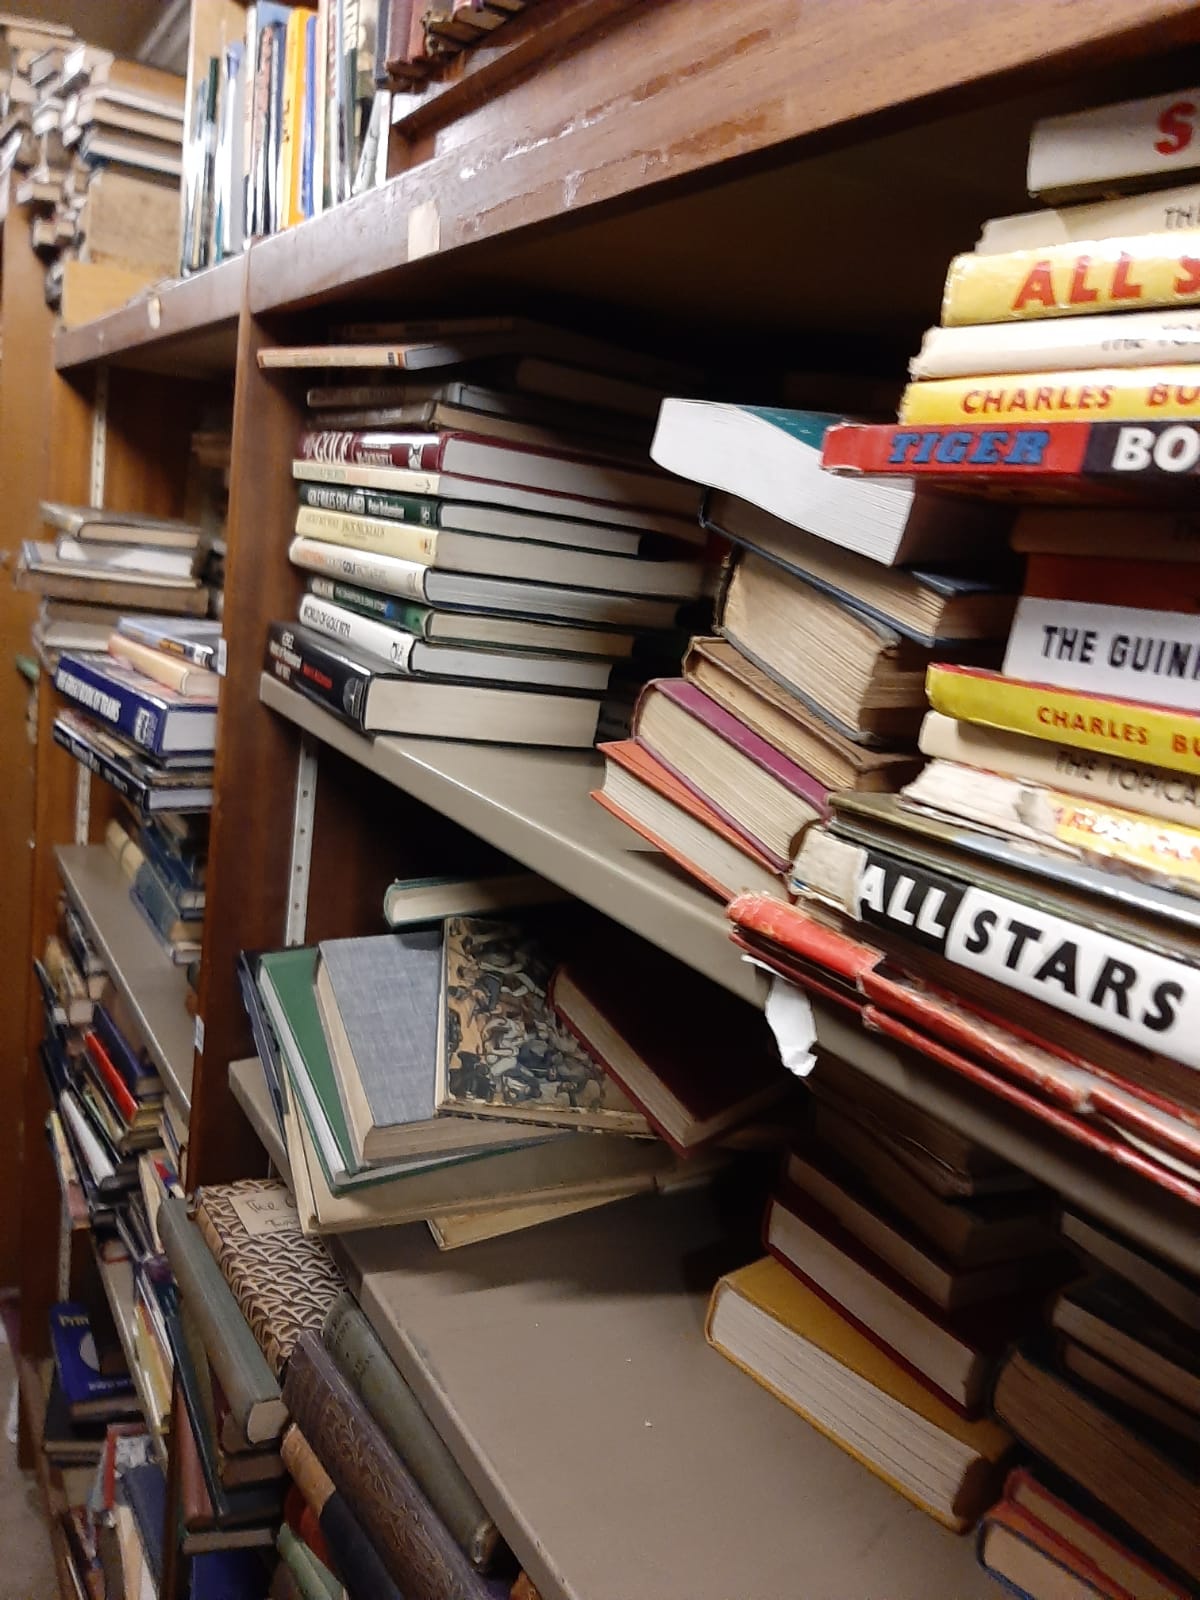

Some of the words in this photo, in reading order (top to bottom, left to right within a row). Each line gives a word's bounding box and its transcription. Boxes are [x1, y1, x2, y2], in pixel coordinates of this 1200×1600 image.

[1010, 250, 1142, 312] ALL
[961, 384, 1117, 415] CHARLES
[887, 429, 1052, 465] TIGER
[1111, 424, 1200, 473] BO
[1041, 624, 1098, 664] THE
[1036, 706, 1149, 746] CHARLES
[1054, 750, 1097, 782] THE
[1106, 760, 1200, 809] TOPICA
[856, 863, 946, 940] ALL
[963, 909, 1185, 1033] STARS
